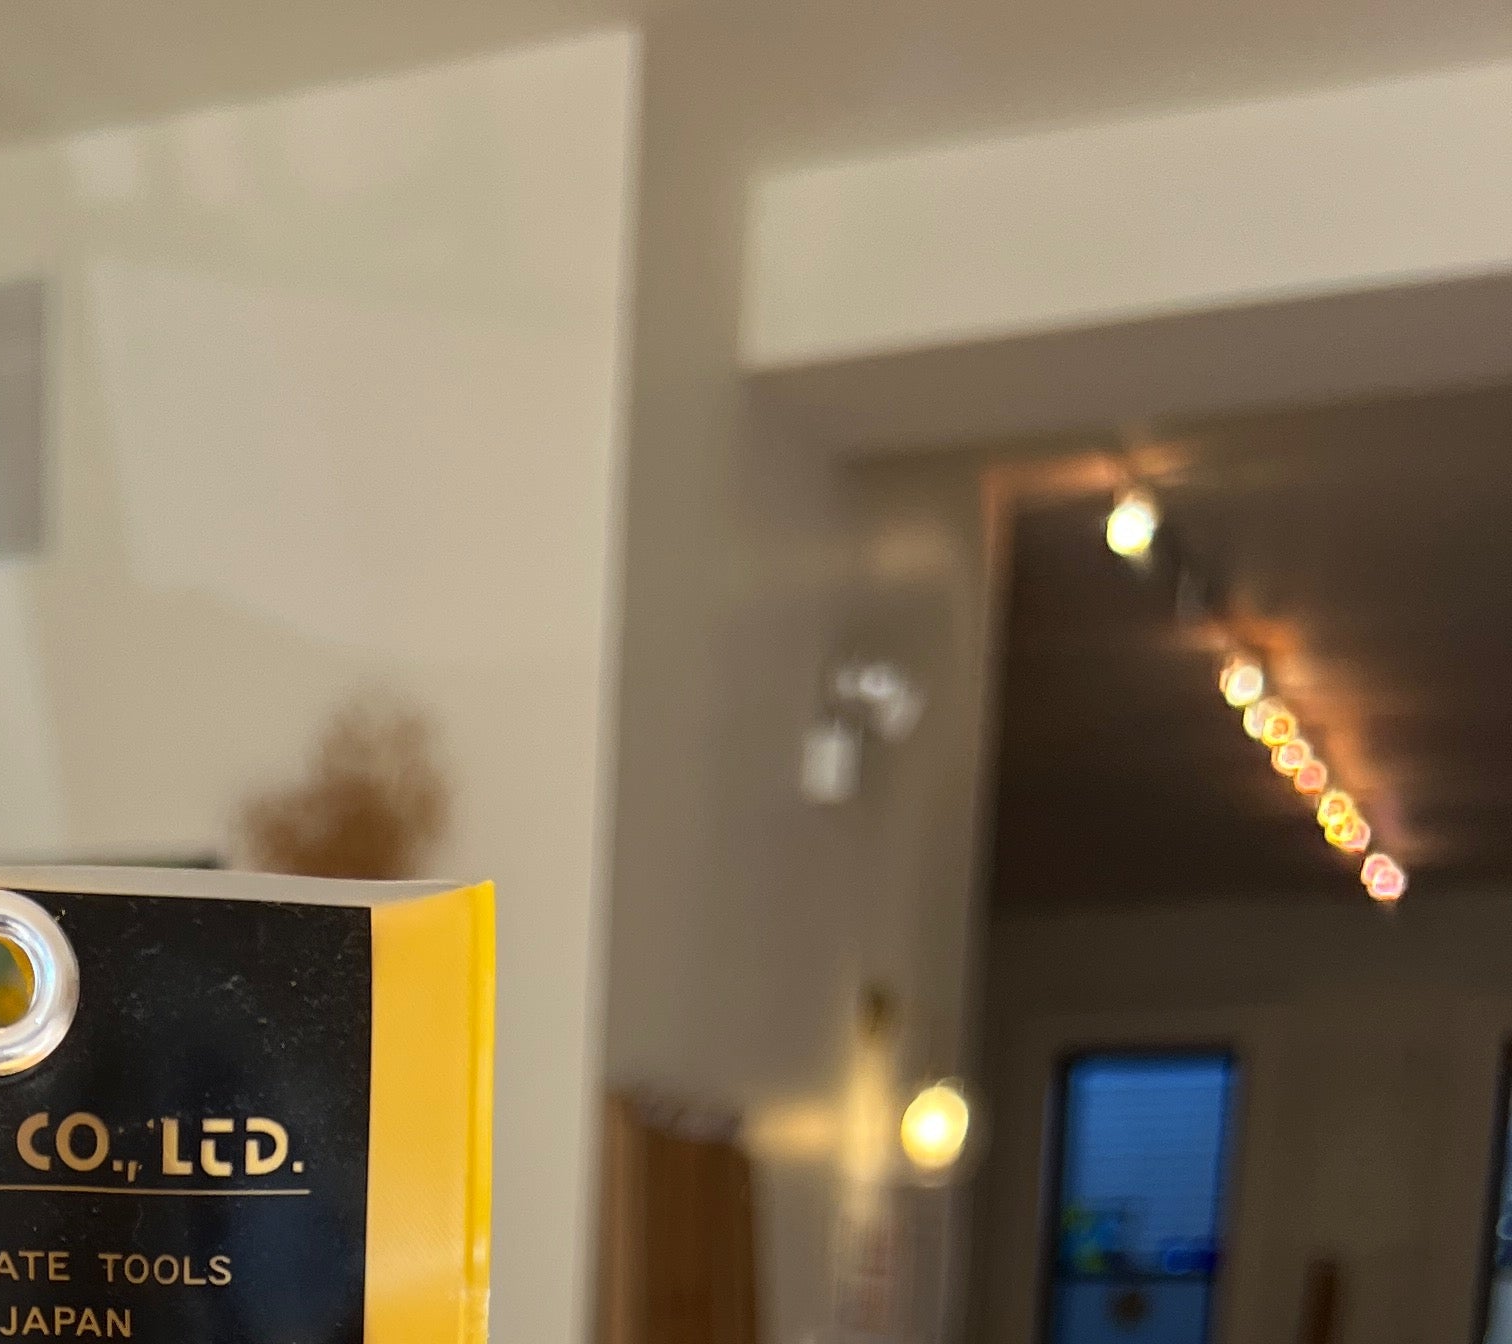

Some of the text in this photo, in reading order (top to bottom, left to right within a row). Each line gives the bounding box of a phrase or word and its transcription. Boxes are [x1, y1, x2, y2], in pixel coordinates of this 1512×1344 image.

[162, 1116, 304, 1177] LTD.
[98, 1252, 233, 1286] TOOLS
[0, 1305, 133, 1338] JAPAN
